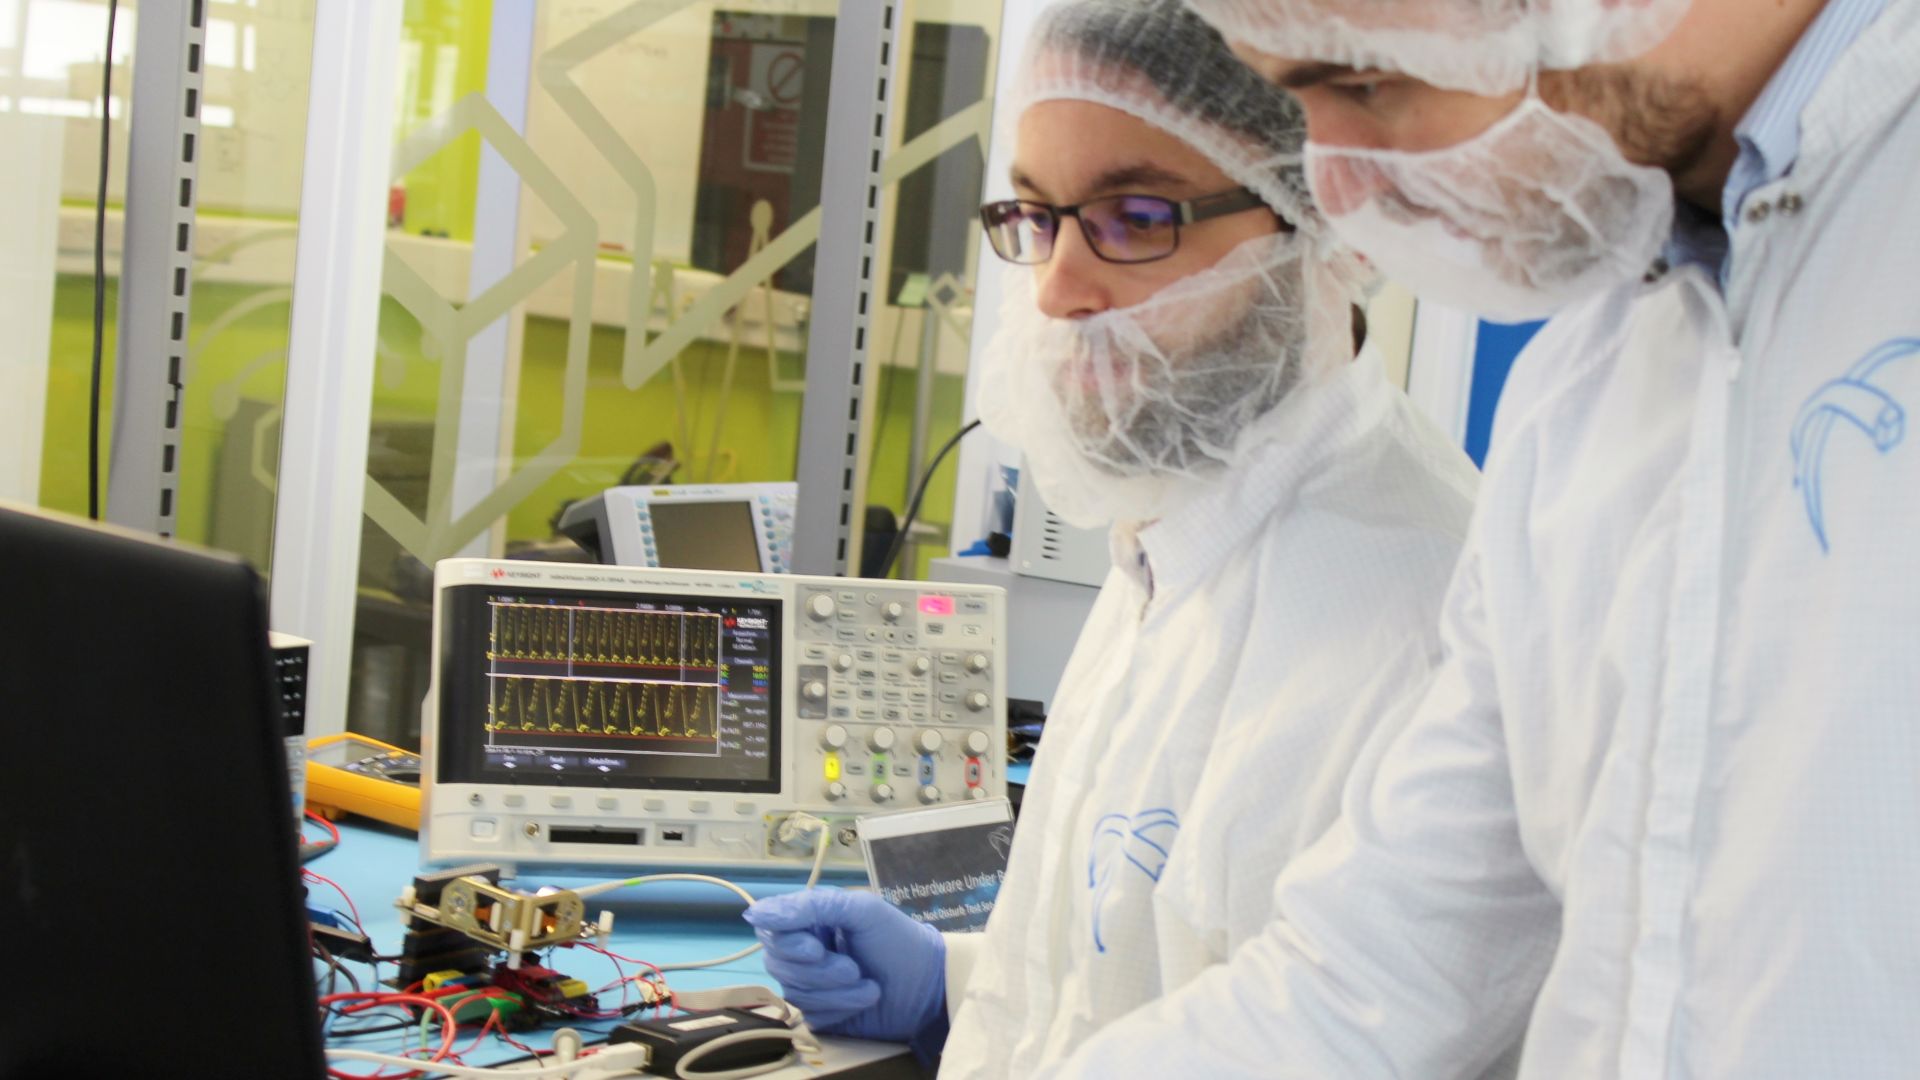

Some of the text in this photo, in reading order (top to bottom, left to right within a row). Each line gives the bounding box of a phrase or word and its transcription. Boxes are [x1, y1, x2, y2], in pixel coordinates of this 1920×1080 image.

[923, 765, 930, 776] 3
[911, 878, 962, 897] Hardware
[963, 872, 995, 889] Under
[923, 908, 939, 921] Not
[939, 904, 966, 919] Disturb
